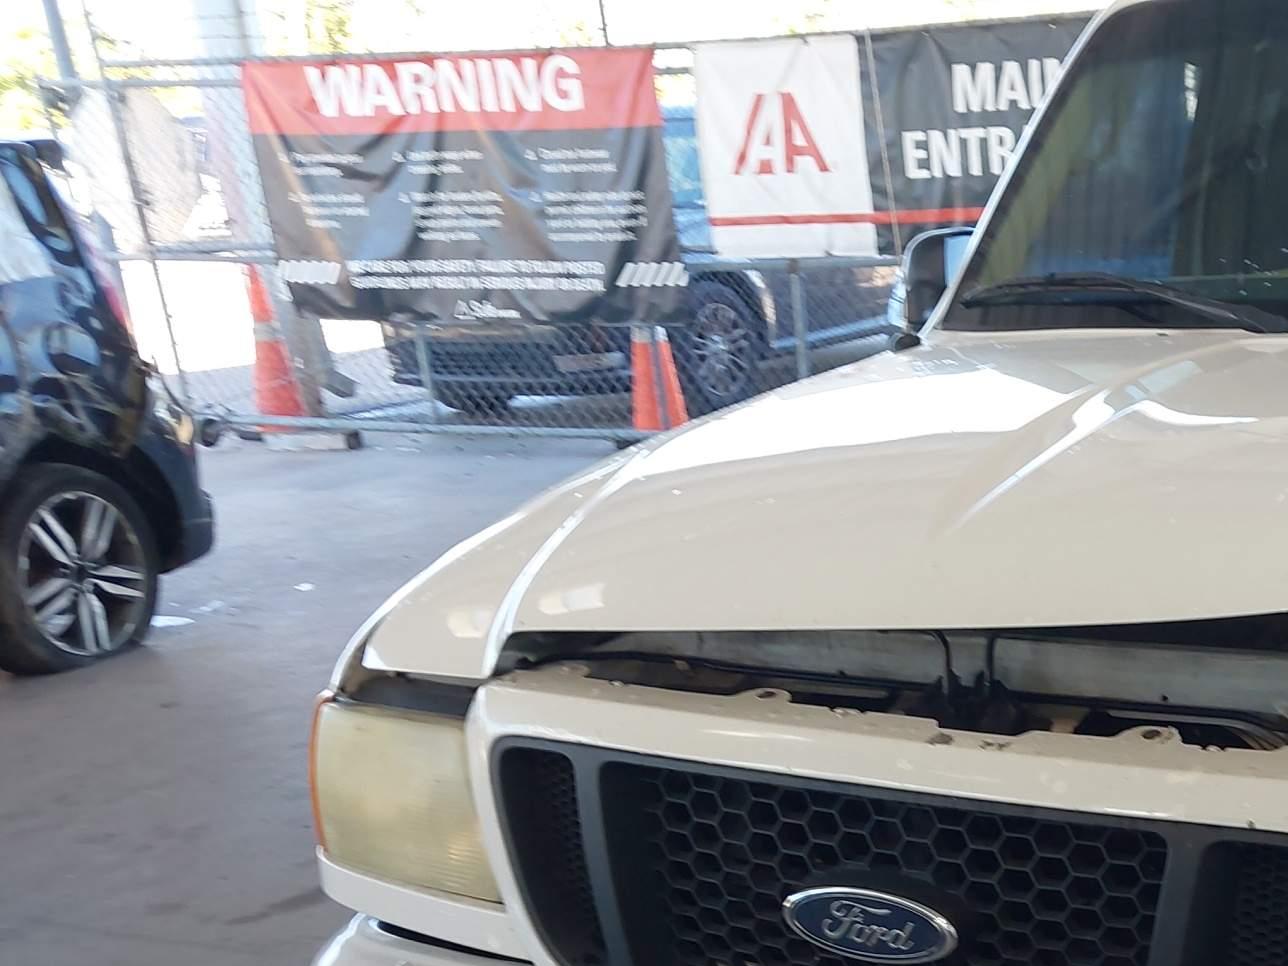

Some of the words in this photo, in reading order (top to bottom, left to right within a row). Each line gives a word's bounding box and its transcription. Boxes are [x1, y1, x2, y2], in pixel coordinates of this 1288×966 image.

[303, 54, 585, 118] WARNING
[902, 125, 1027, 179] ENTR
[821, 899, 915, 950] Ford
